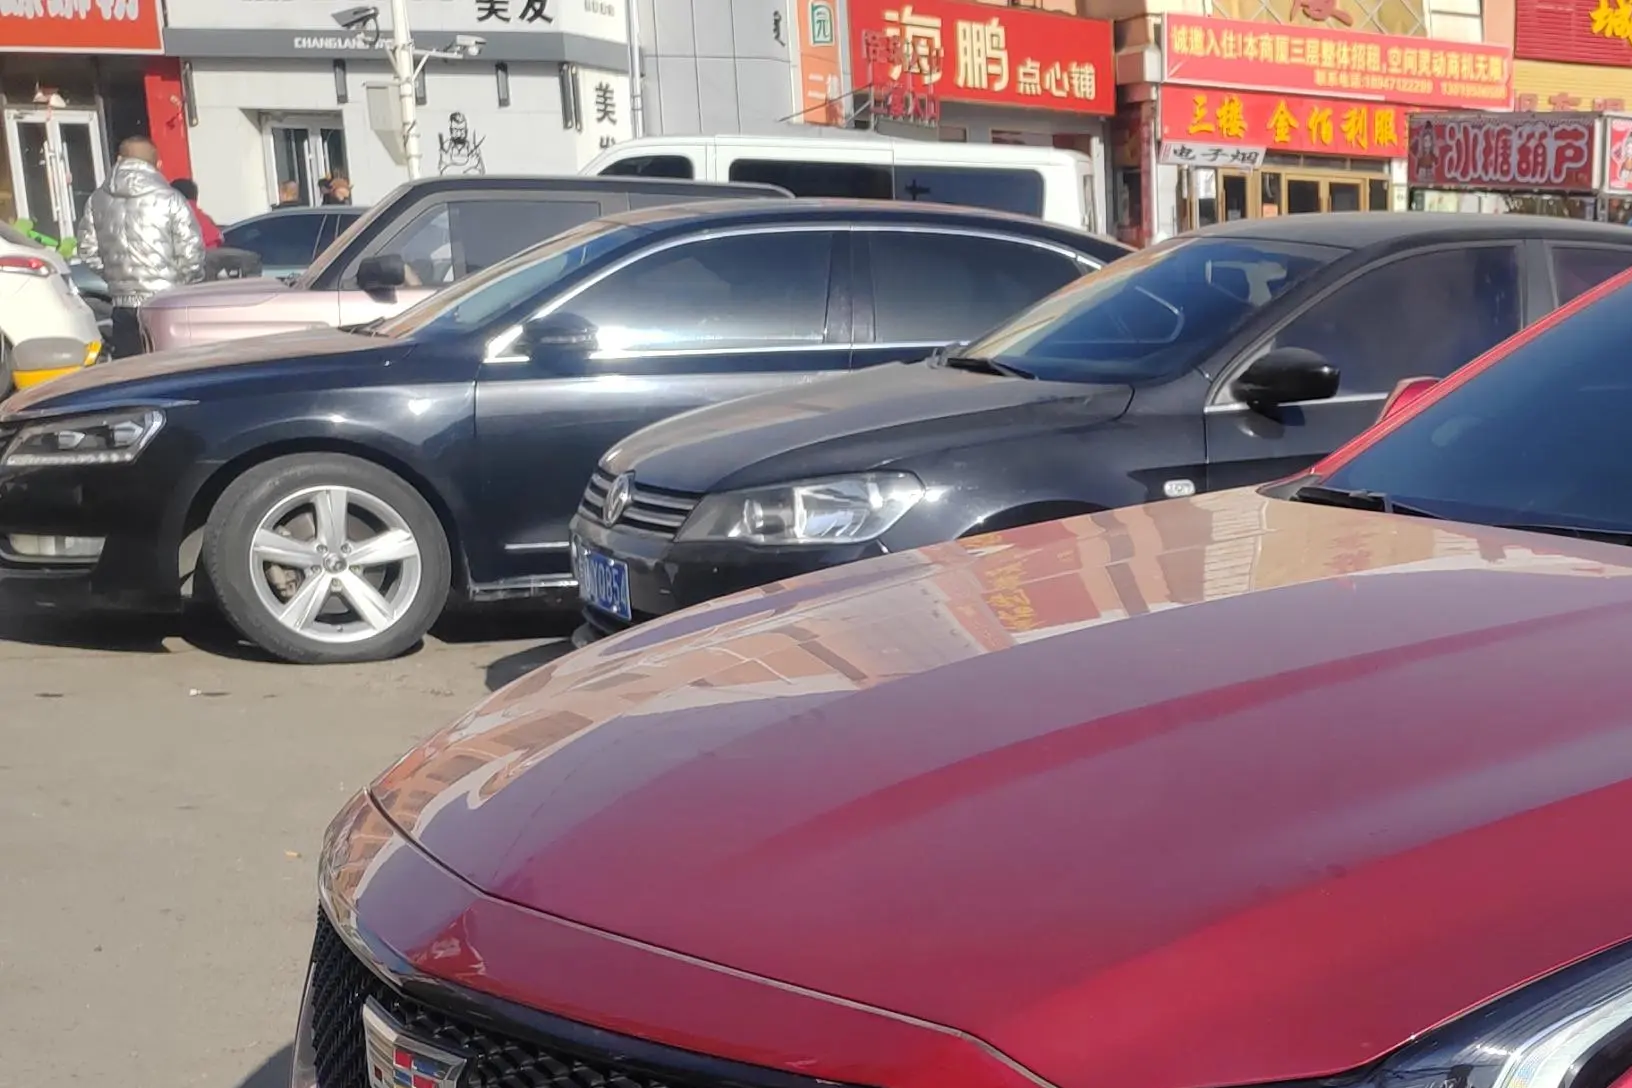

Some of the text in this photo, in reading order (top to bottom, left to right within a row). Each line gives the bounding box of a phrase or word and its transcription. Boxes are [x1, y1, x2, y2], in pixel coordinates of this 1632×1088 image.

[1016, 57, 1096, 101] 点心铺
[1173, 146, 1260, 166] 电子烟
